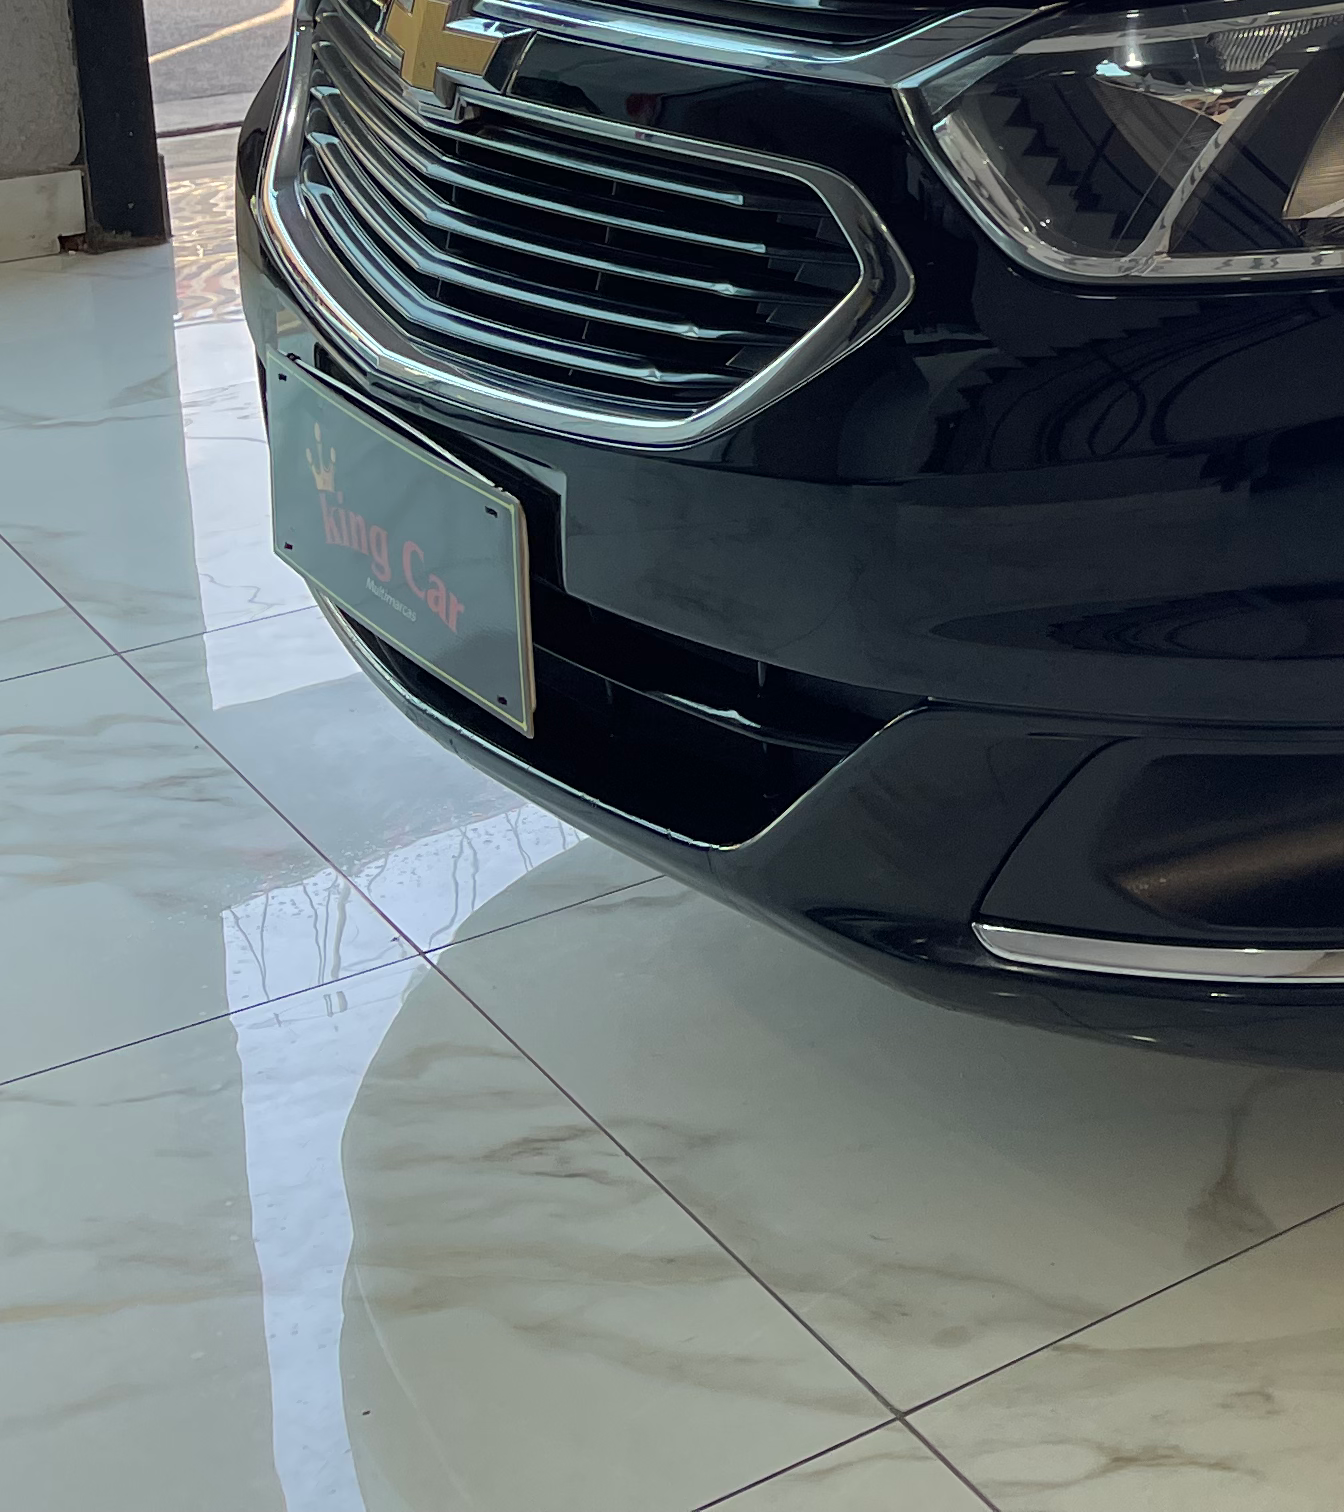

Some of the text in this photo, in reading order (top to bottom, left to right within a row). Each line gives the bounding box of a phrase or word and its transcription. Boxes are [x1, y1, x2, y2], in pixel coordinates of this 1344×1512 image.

[318, 489, 465, 634] king Car
[365, 576, 417, 623] Multimarcas
